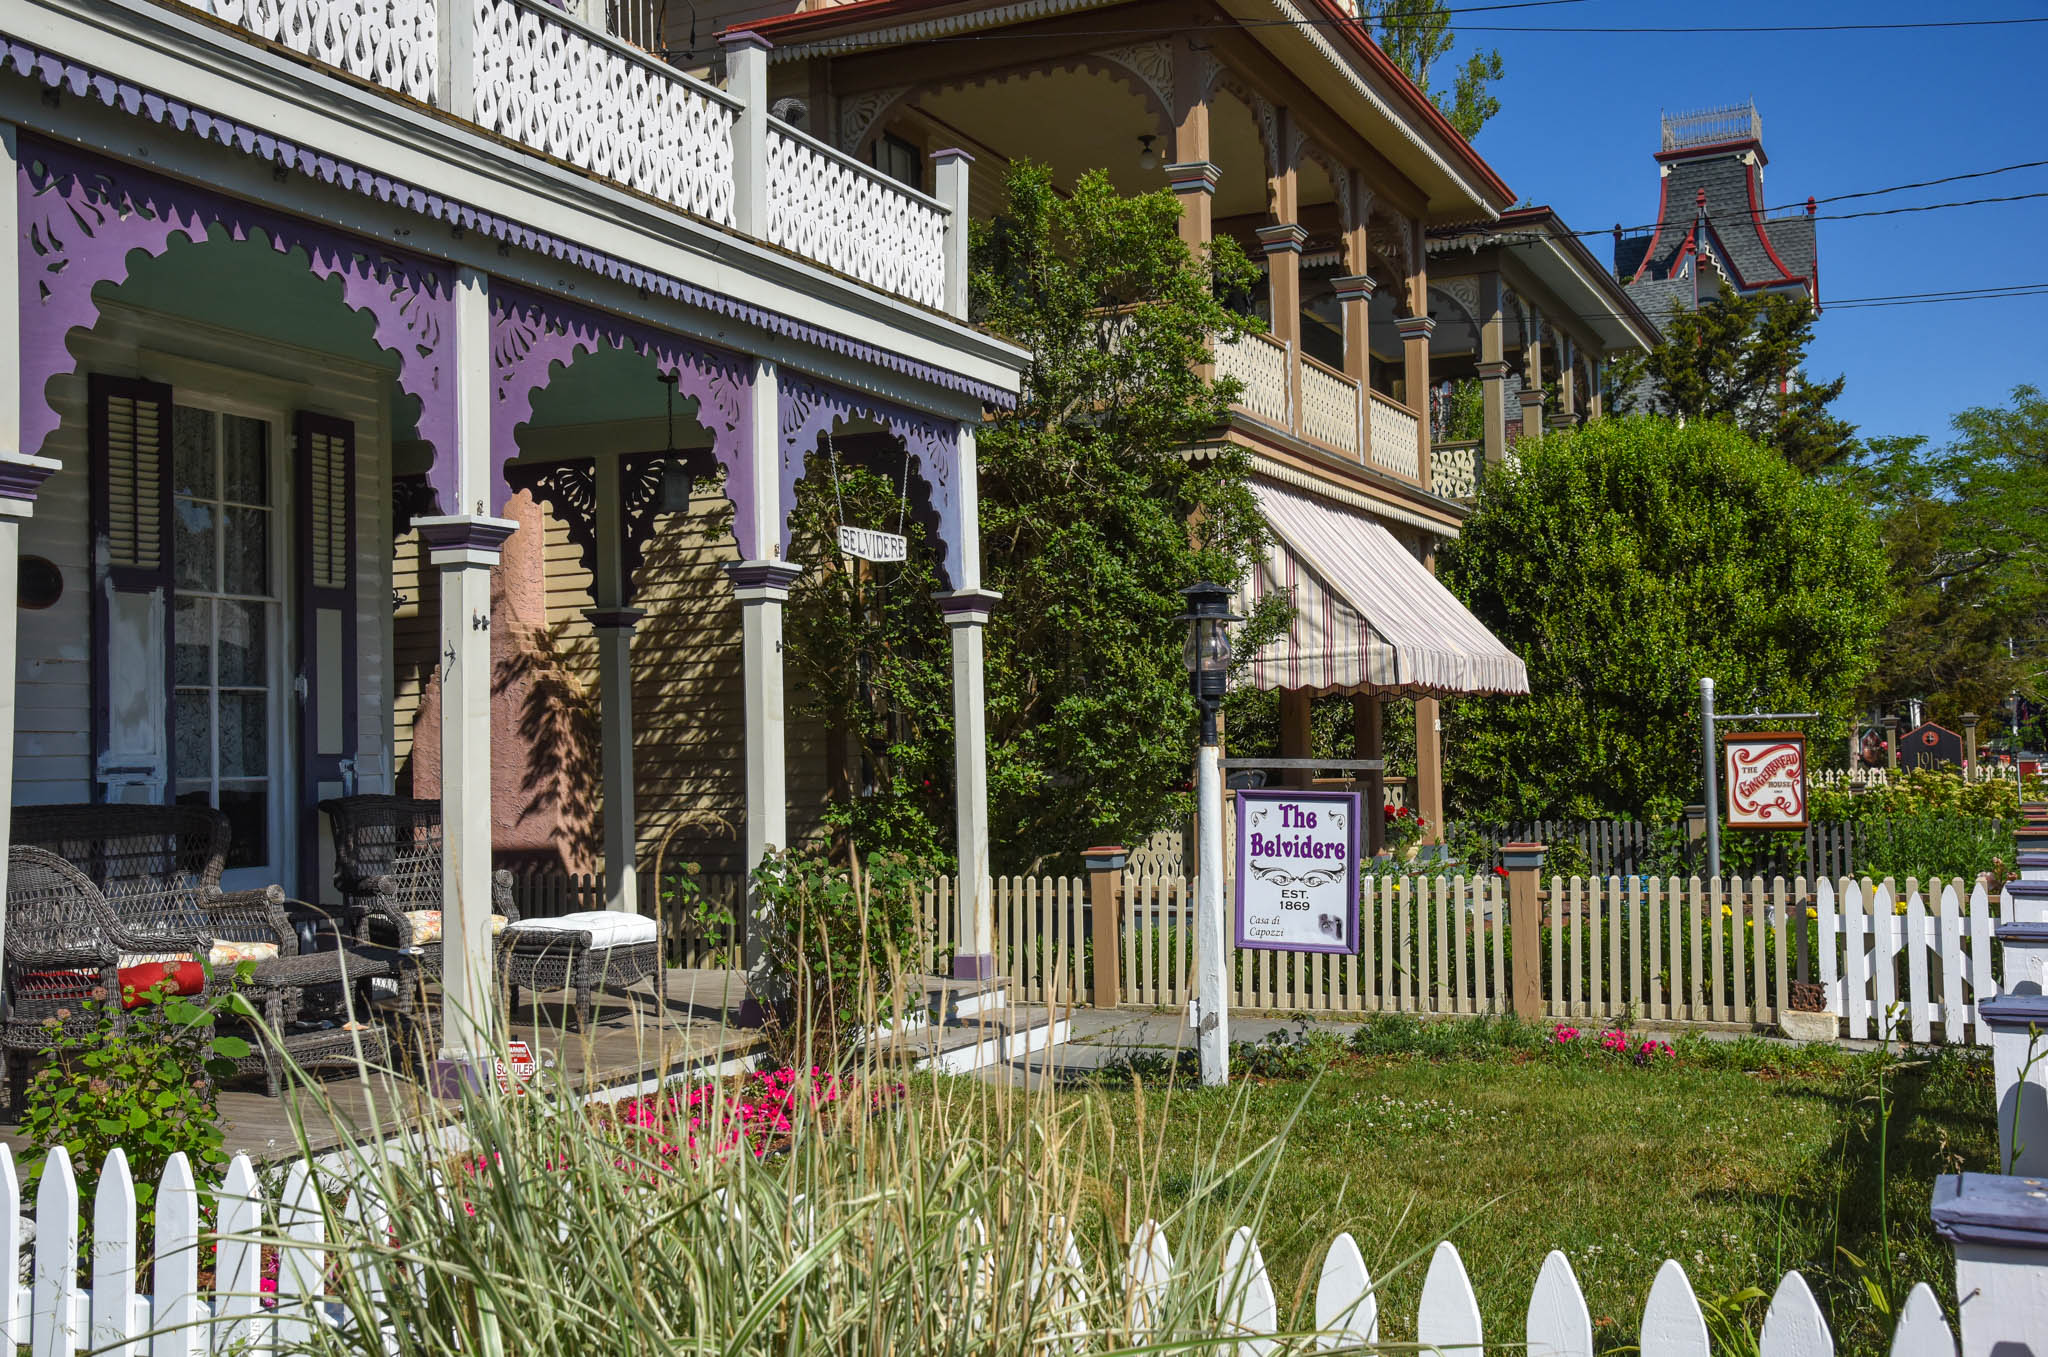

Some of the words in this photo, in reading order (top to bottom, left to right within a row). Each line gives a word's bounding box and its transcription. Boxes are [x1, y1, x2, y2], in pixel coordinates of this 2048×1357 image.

[841, 528, 905, 559] BELVIDERE
[1738, 752, 1798, 799] GINGERBREAD
[1741, 766, 1758, 774] THE
[1767, 781, 1792, 789] HOUSE
[1278, 803, 1318, 829] The
[1250, 832, 1346, 860] Belvidere
[1281, 889, 1309, 899] EST.
[1279, 900, 1310, 911] 1869
[1249, 915, 1269, 925] Casa
[1271, 915, 1281, 925] di
[1249, 926, 1284, 939] Capozzi
